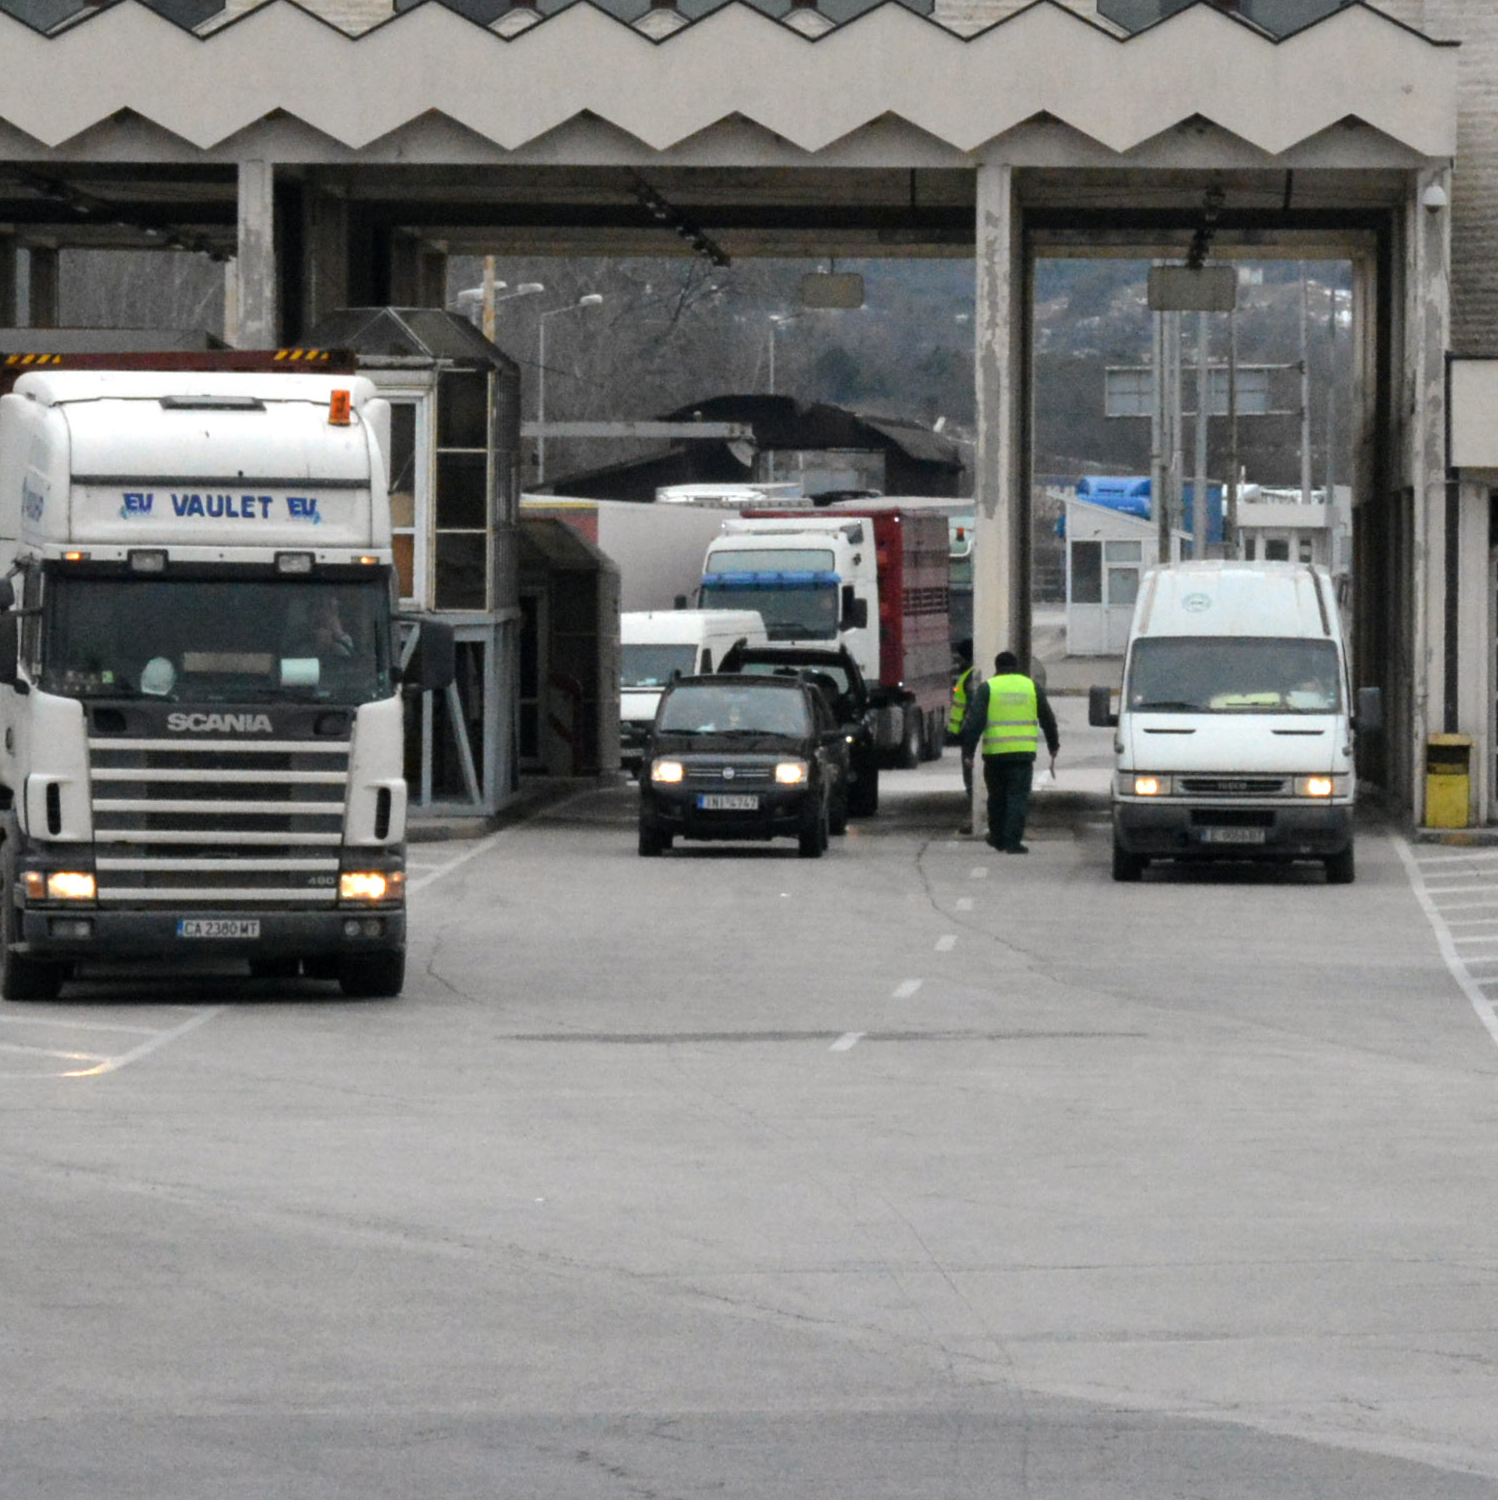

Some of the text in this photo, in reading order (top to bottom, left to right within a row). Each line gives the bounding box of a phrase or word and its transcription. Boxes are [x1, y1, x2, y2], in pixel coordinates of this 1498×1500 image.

[123, 493, 153, 510] EU
[170, 493, 273, 519] VAULET
[167, 712, 273, 732] SCANIA
[184, 923, 200, 934] CA
